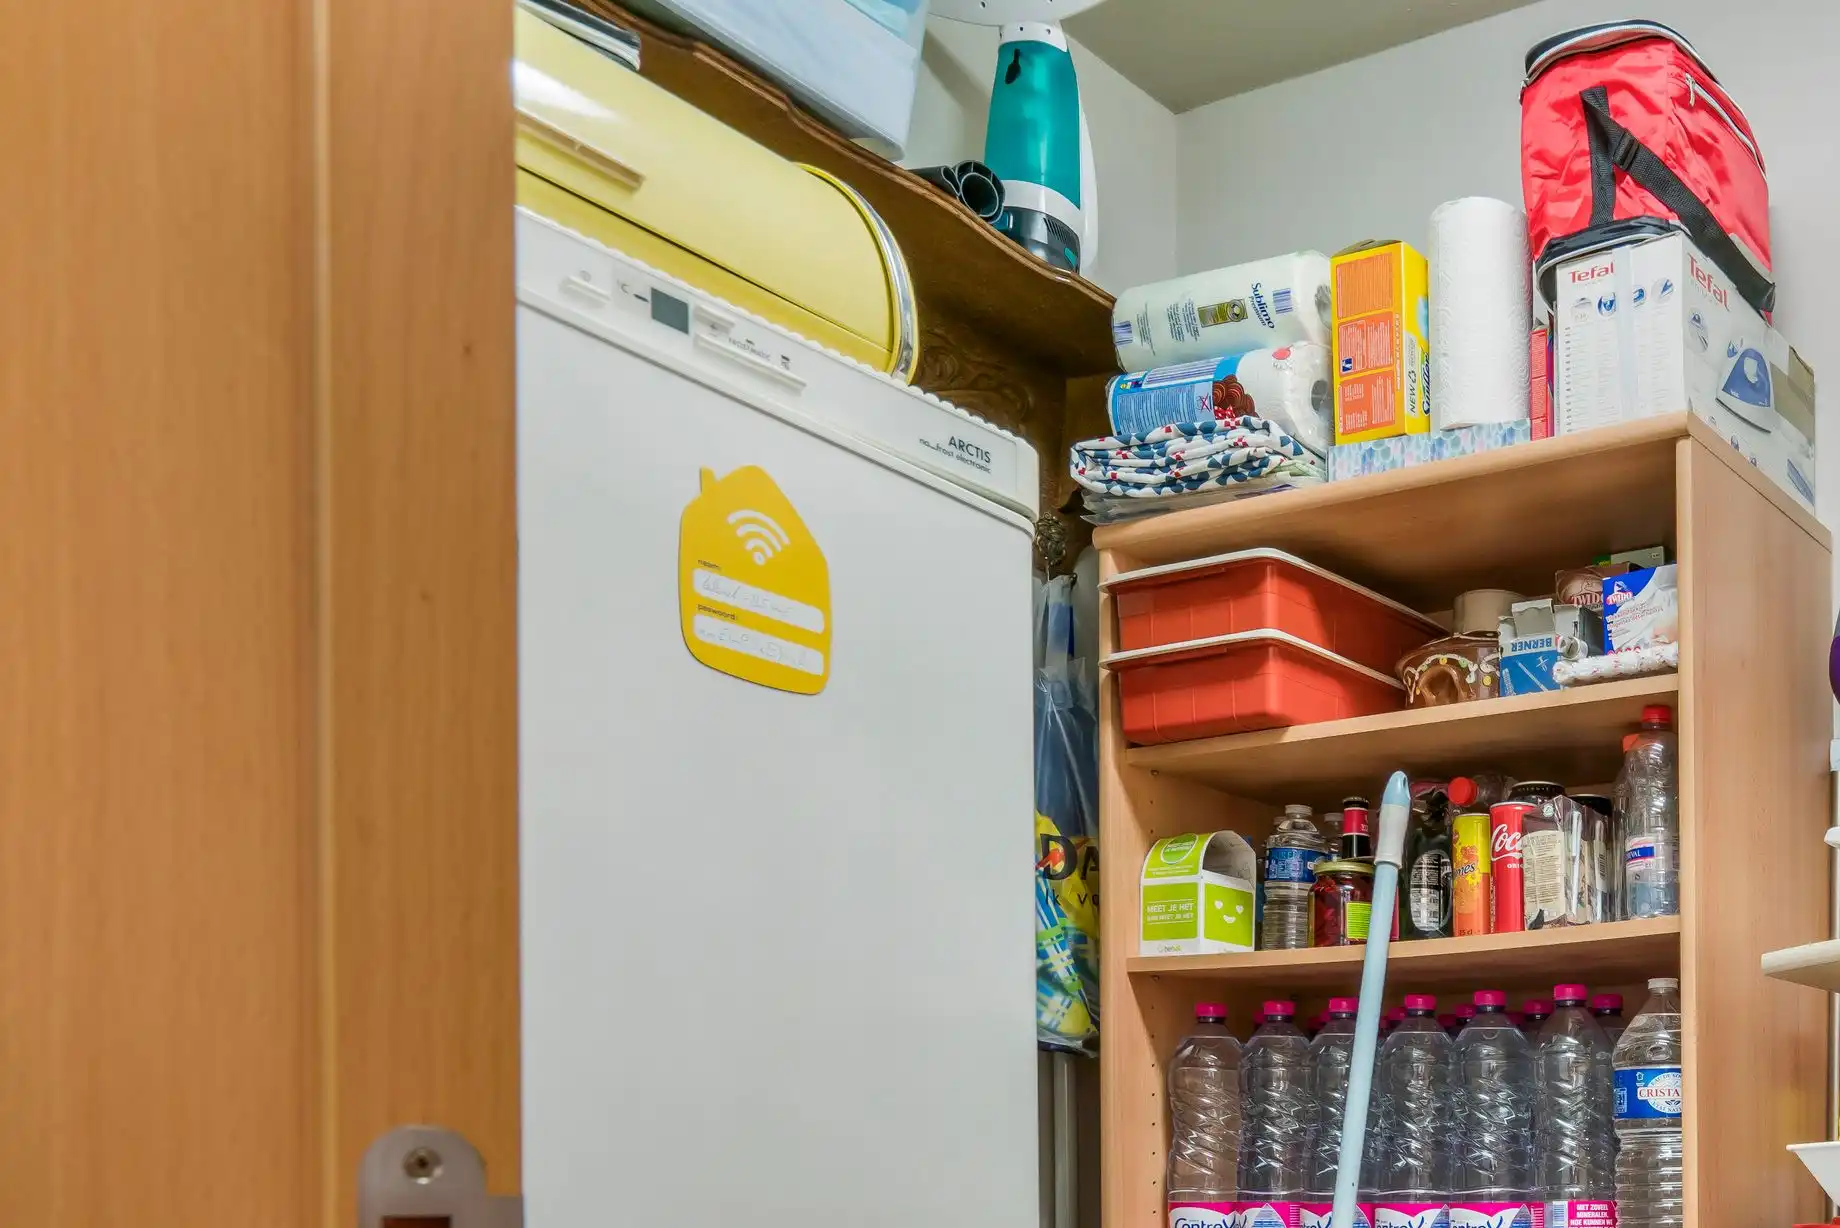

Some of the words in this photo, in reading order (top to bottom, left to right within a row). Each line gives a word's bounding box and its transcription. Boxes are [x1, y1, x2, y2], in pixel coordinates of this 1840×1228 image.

[1568, 263, 1615, 284] Tefal
[1688, 253, 1731, 312] Tefal
[1251, 282, 1275, 329] Sublimo
[1409, 383, 1417, 414] NEW
[948, 436, 991, 463] ARCTIS
[1571, 592, 1602, 606] TWID
[1511, 637, 1553, 652] BERNER
[1491, 823, 1523, 852] Coc
[1147, 904, 1166, 914] MEET
[1168, 903, 1178, 912] JE
[1179, 902, 1194, 911] HET
[1639, 1088, 1680, 1098] CRISTA
[1576, 1203, 1589, 1211] MET
